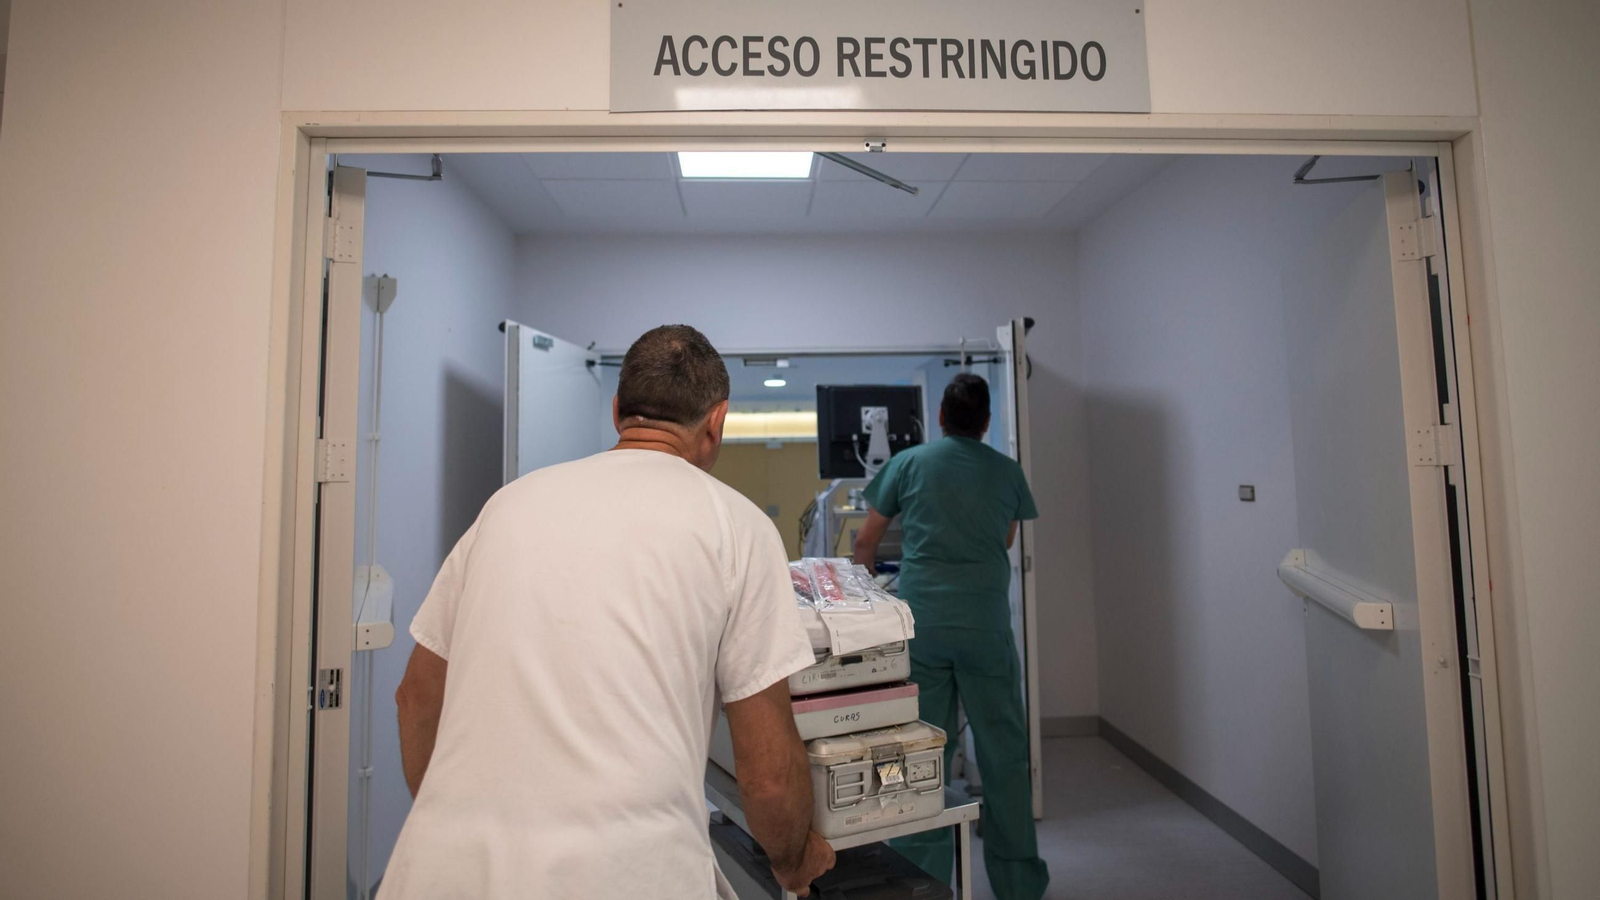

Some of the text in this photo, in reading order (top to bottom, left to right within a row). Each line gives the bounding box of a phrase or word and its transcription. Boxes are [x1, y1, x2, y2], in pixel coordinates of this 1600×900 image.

[653, 34, 1107, 82] ACCESO RESTRINGIDO
[833, 711, 861, 724] CURAS
